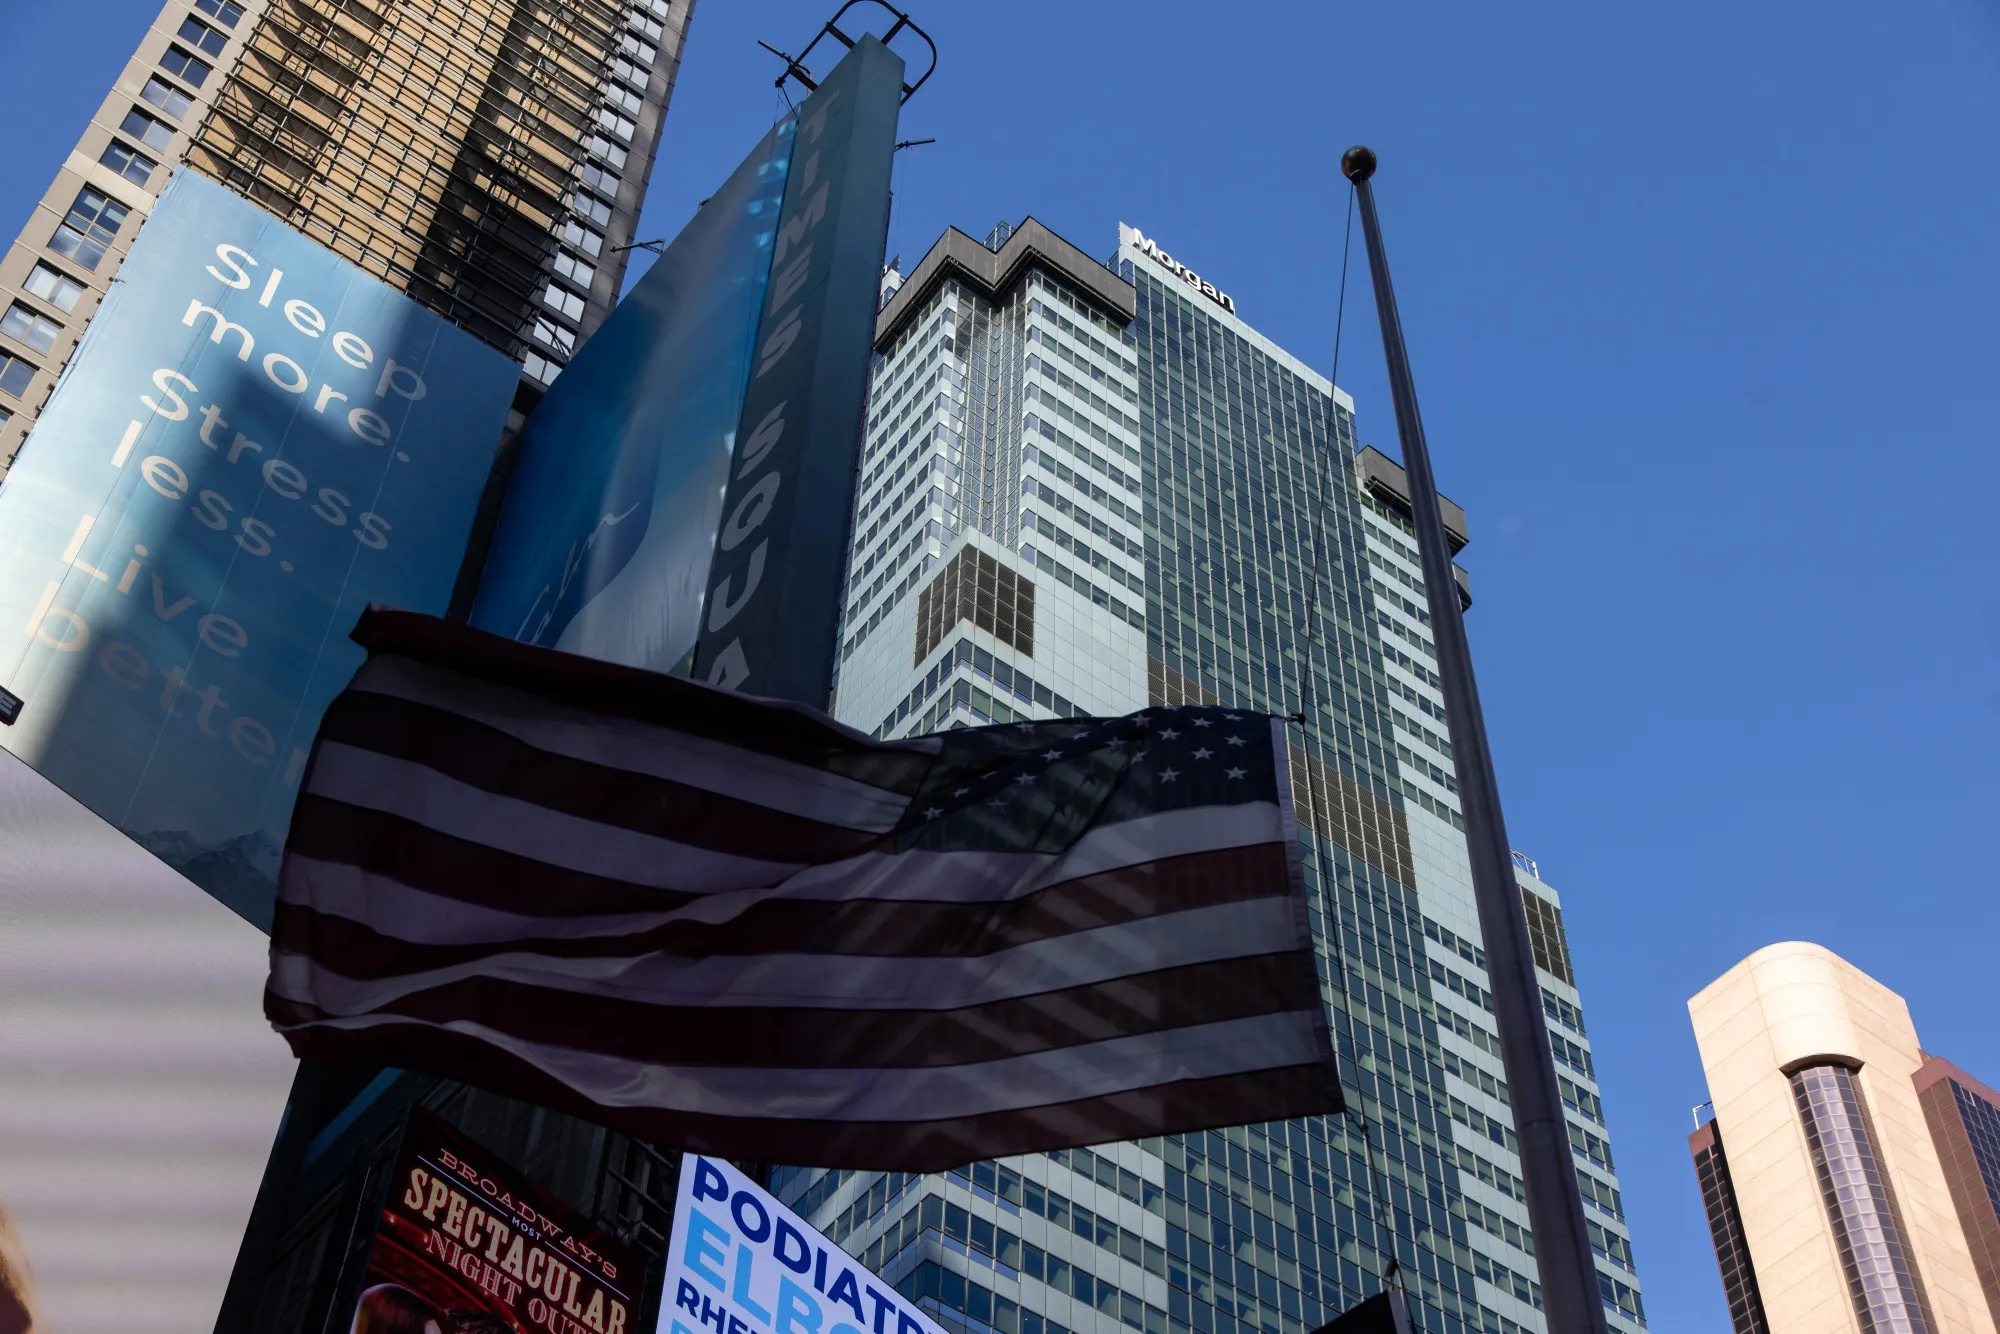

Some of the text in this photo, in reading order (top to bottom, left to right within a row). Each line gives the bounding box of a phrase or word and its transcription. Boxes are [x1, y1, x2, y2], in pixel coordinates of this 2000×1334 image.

[758, 89, 840, 380] TIMES
[1132, 227, 1236, 317] Morgan
[181, 298, 411, 463] more.
[205, 243, 428, 402] Sleep
[110, 419, 295, 573] less.
[140, 368, 393, 551] Stress
[62, 514, 249, 658] Live
[404, 1168, 627, 1334] SPECTACULAR
[425, 1228, 522, 1308] NIGHT
[437, 1148, 617, 1279] BROADWAY'S
[511, 1216, 542, 1241] MOST
[683, 1206, 866, 1334] ELB
